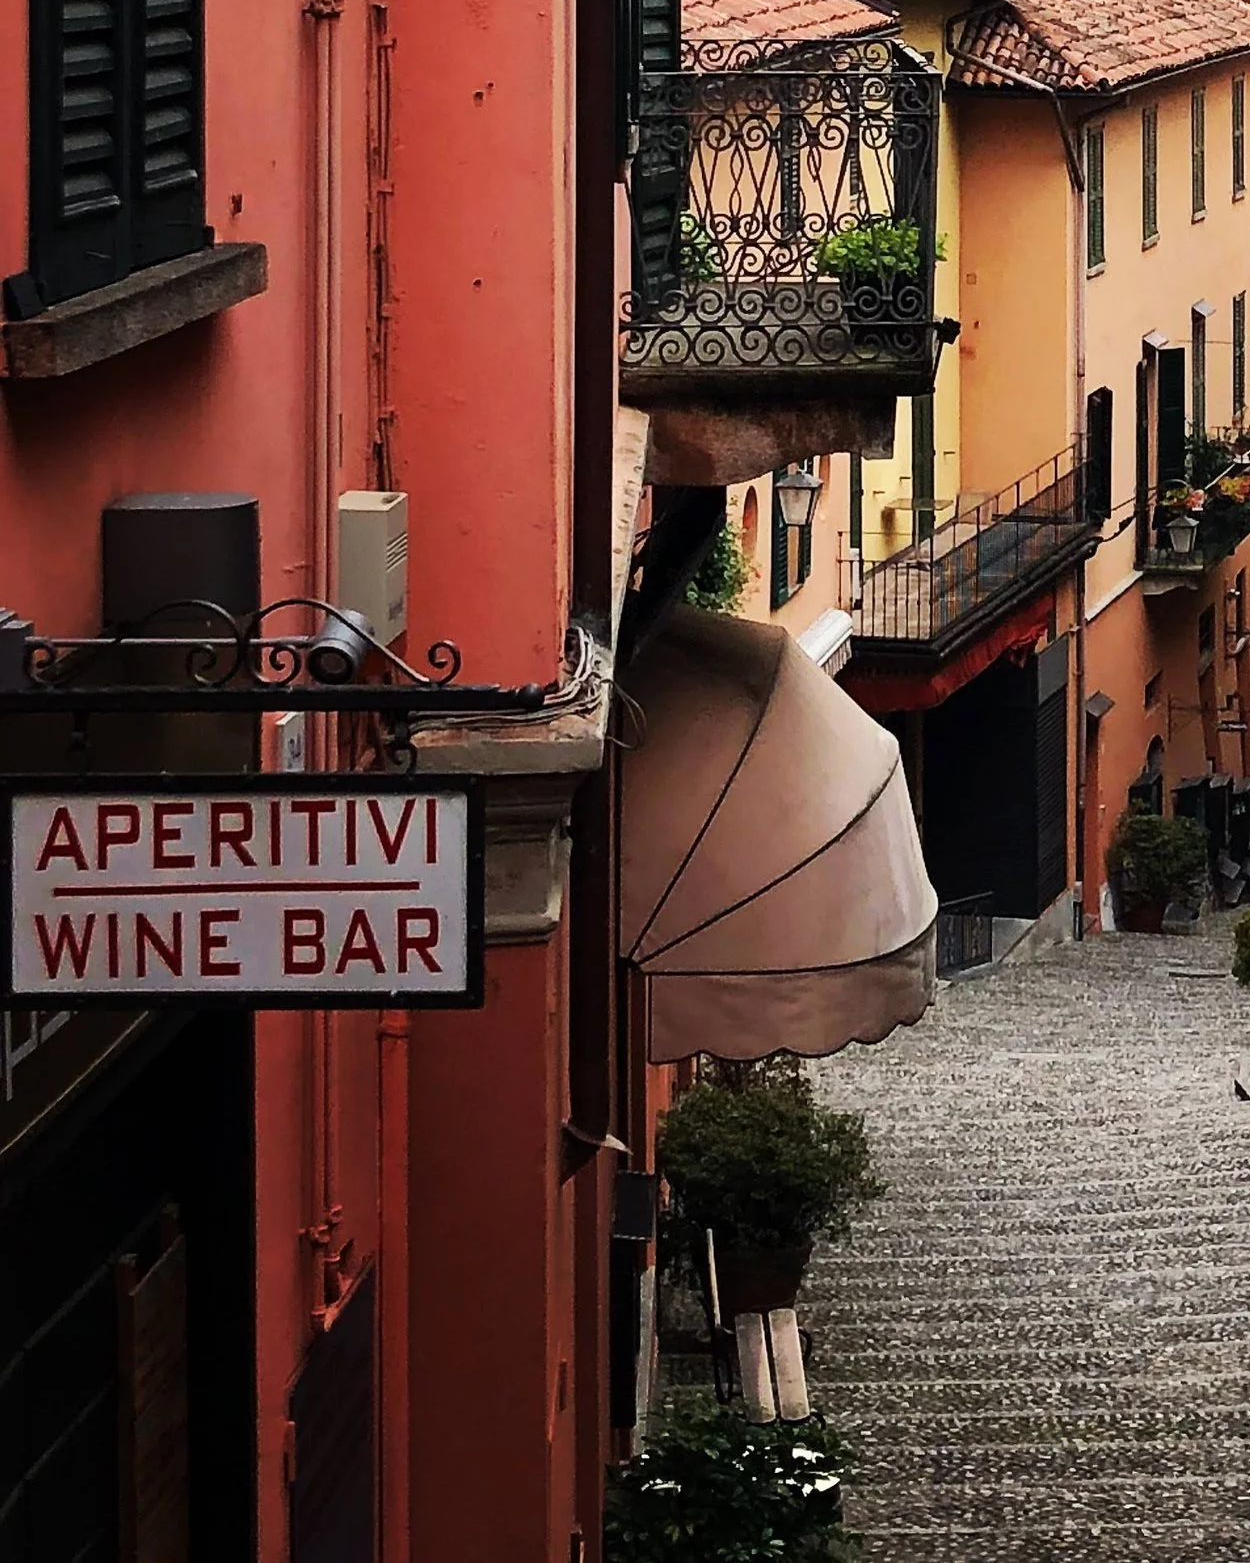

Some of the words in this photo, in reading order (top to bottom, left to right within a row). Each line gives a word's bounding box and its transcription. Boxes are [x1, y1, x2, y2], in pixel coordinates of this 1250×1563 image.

[35, 798, 438, 871] APERITIVI
[34, 909, 241, 979] WINE
[281, 907, 443, 975] BAR
